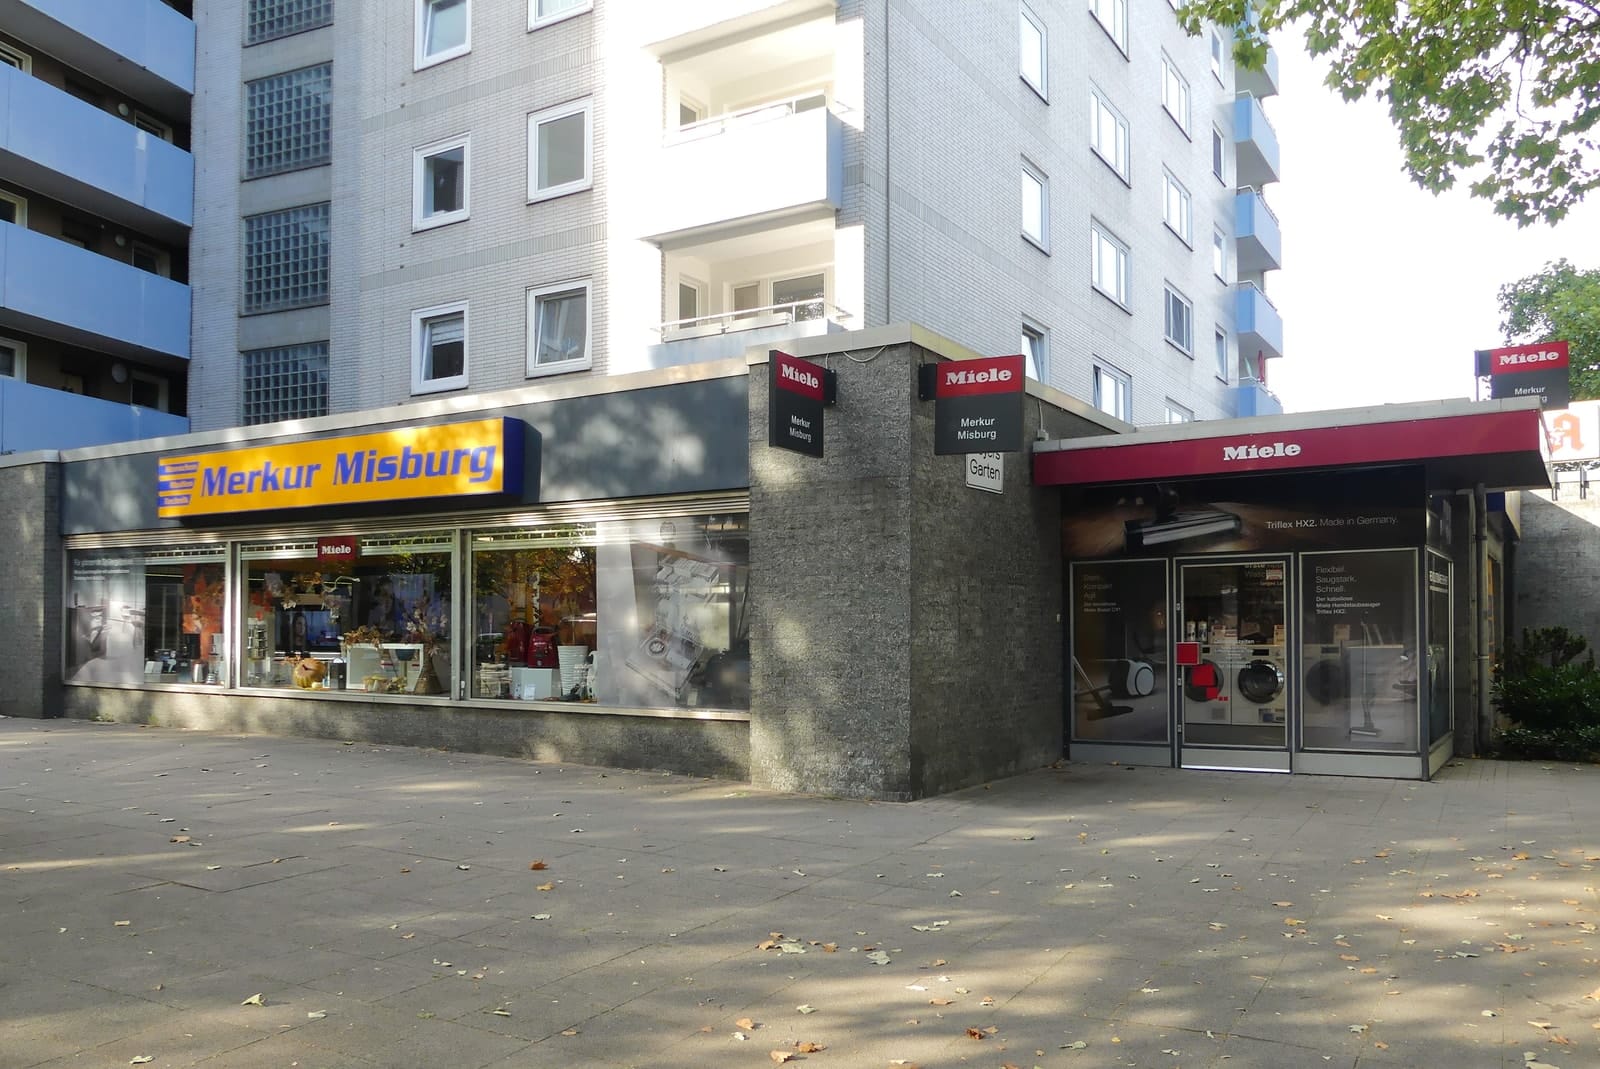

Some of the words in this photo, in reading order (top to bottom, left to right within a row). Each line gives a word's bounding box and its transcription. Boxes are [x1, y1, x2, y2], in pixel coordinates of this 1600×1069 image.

[1499, 350, 1559, 366] Miele
[781, 363, 819, 389] Miele
[945, 368, 1012, 386] Miele
[1515, 386, 1546, 396] Merkur
[791, 415, 811, 429] Merkur
[960, 417, 995, 428] Merkur
[789, 427, 812, 443] Misburg
[957, 429, 997, 441] Misburg
[1224, 442, 1301, 461] Miele
[200, 460, 322, 497] Merkur
[333, 444, 497, 486] Misburg
[970, 458, 1001, 481] Garten
[1266, 521, 1293, 529] Triflex
[1295, 519, 1318, 528] HX2.
[1320, 518, 1345, 526] Made
[1347, 517, 1355, 526] in
[321, 544, 352, 556] Miele
